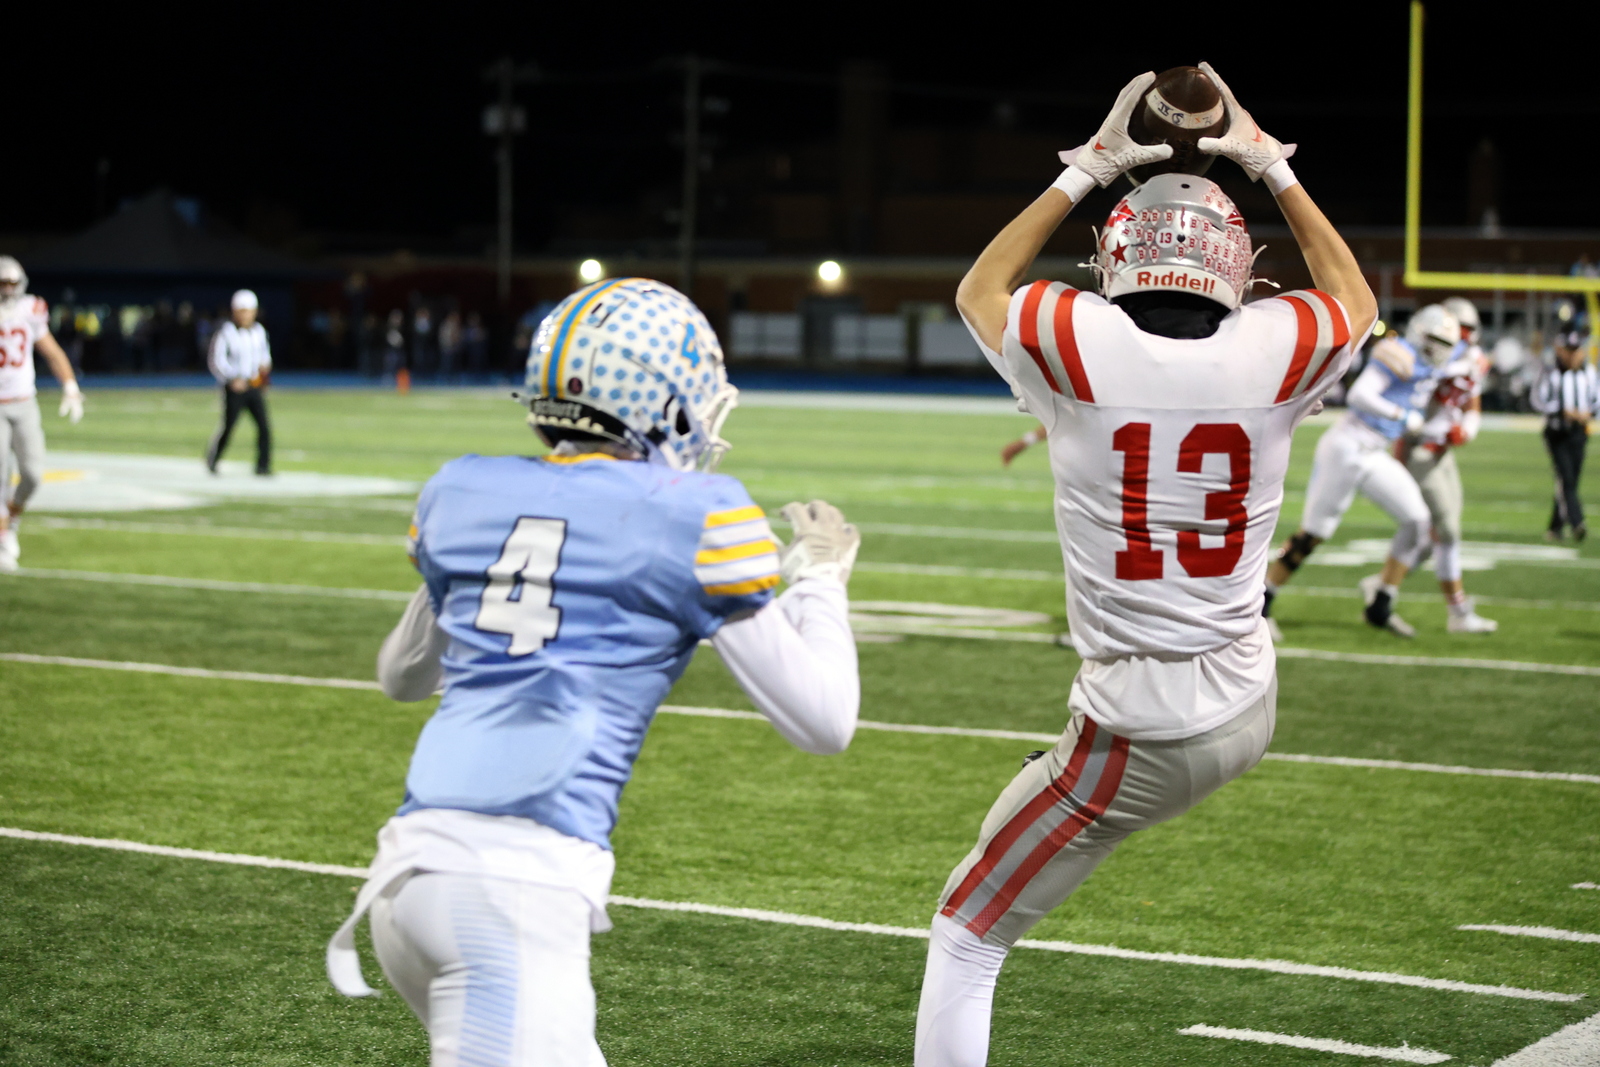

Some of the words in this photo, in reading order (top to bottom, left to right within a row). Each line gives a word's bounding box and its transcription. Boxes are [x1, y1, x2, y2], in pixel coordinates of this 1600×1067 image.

[1160, 232, 1172, 243] 13
[1137, 271, 1216, 294] Riddell
[681, 321, 701, 370] 4
[1112, 422, 1251, 581] 13
[474, 515, 568, 658] 4
